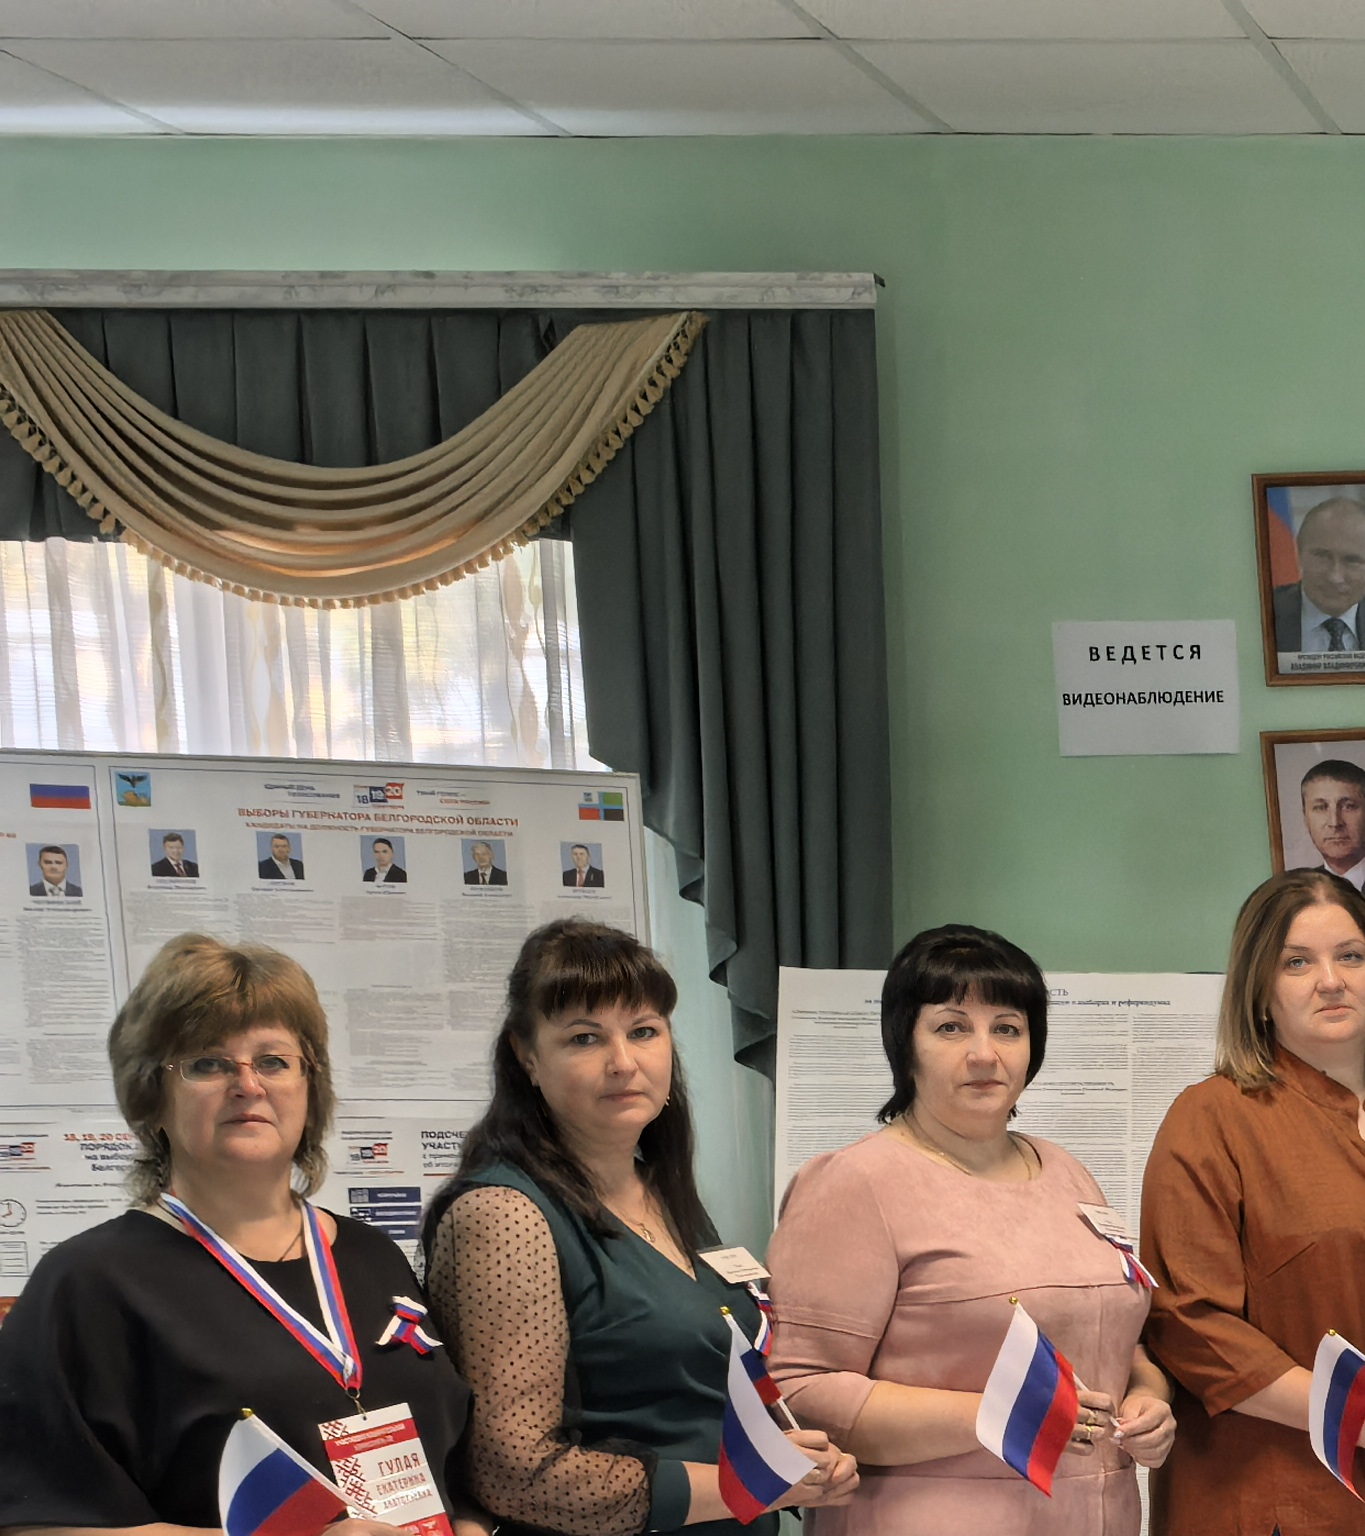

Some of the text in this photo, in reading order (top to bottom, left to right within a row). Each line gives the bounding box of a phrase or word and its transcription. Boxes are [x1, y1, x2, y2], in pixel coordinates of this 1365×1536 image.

[1089, 645, 1201, 665] ВЕДЕТСЯ
[1062, 690, 1224, 708] ВИДЕОНАБЛЮДЕНИЕ
[357, 795, 368, 804] 18
[385, 786, 402, 797] 20
[237, 808, 519, 827] ВЫБОРЫ ГУБЕРНАТОРА БЕЛГОРОДСКОЙ ОБЛАСТИ
[421, 1131, 467, 1140] ПОДСЧЕ
[377, 1452, 421, 1477] ГУЛАЯ
[376, 1472, 426, 1496] ЕКАТЕРИНА
